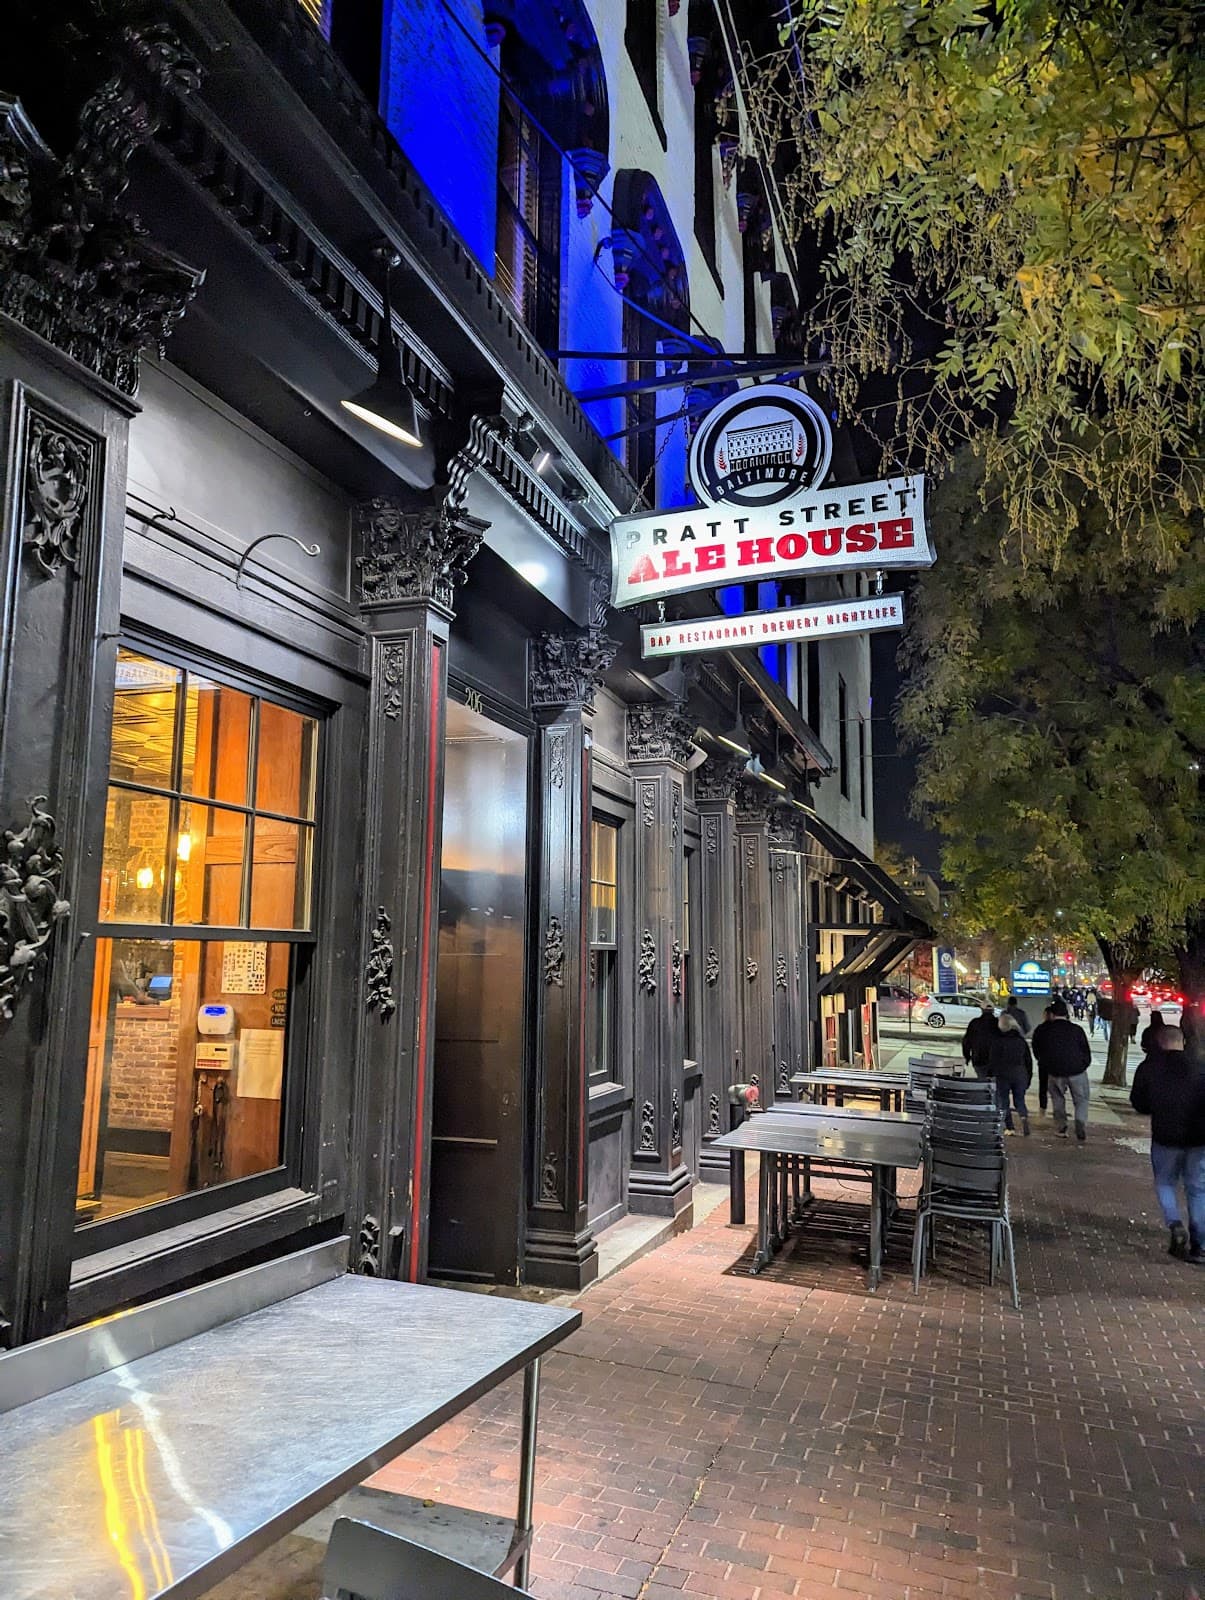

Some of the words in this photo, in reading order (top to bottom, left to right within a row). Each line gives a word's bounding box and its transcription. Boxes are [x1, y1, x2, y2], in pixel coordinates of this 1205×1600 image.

[715, 467, 808, 496] BALTIMORE
[626, 517, 750, 550] PRATT
[779, 488, 916, 526] STREET
[627, 543, 727, 585] ALE
[736, 517, 915, 567] HOUSE
[679, 624, 755, 644] RESTAURANT
[762, 616, 819, 634] BREWERY
[826, 606, 897, 625] NIGHTLIFE
[465, 687, 483, 713] 206
